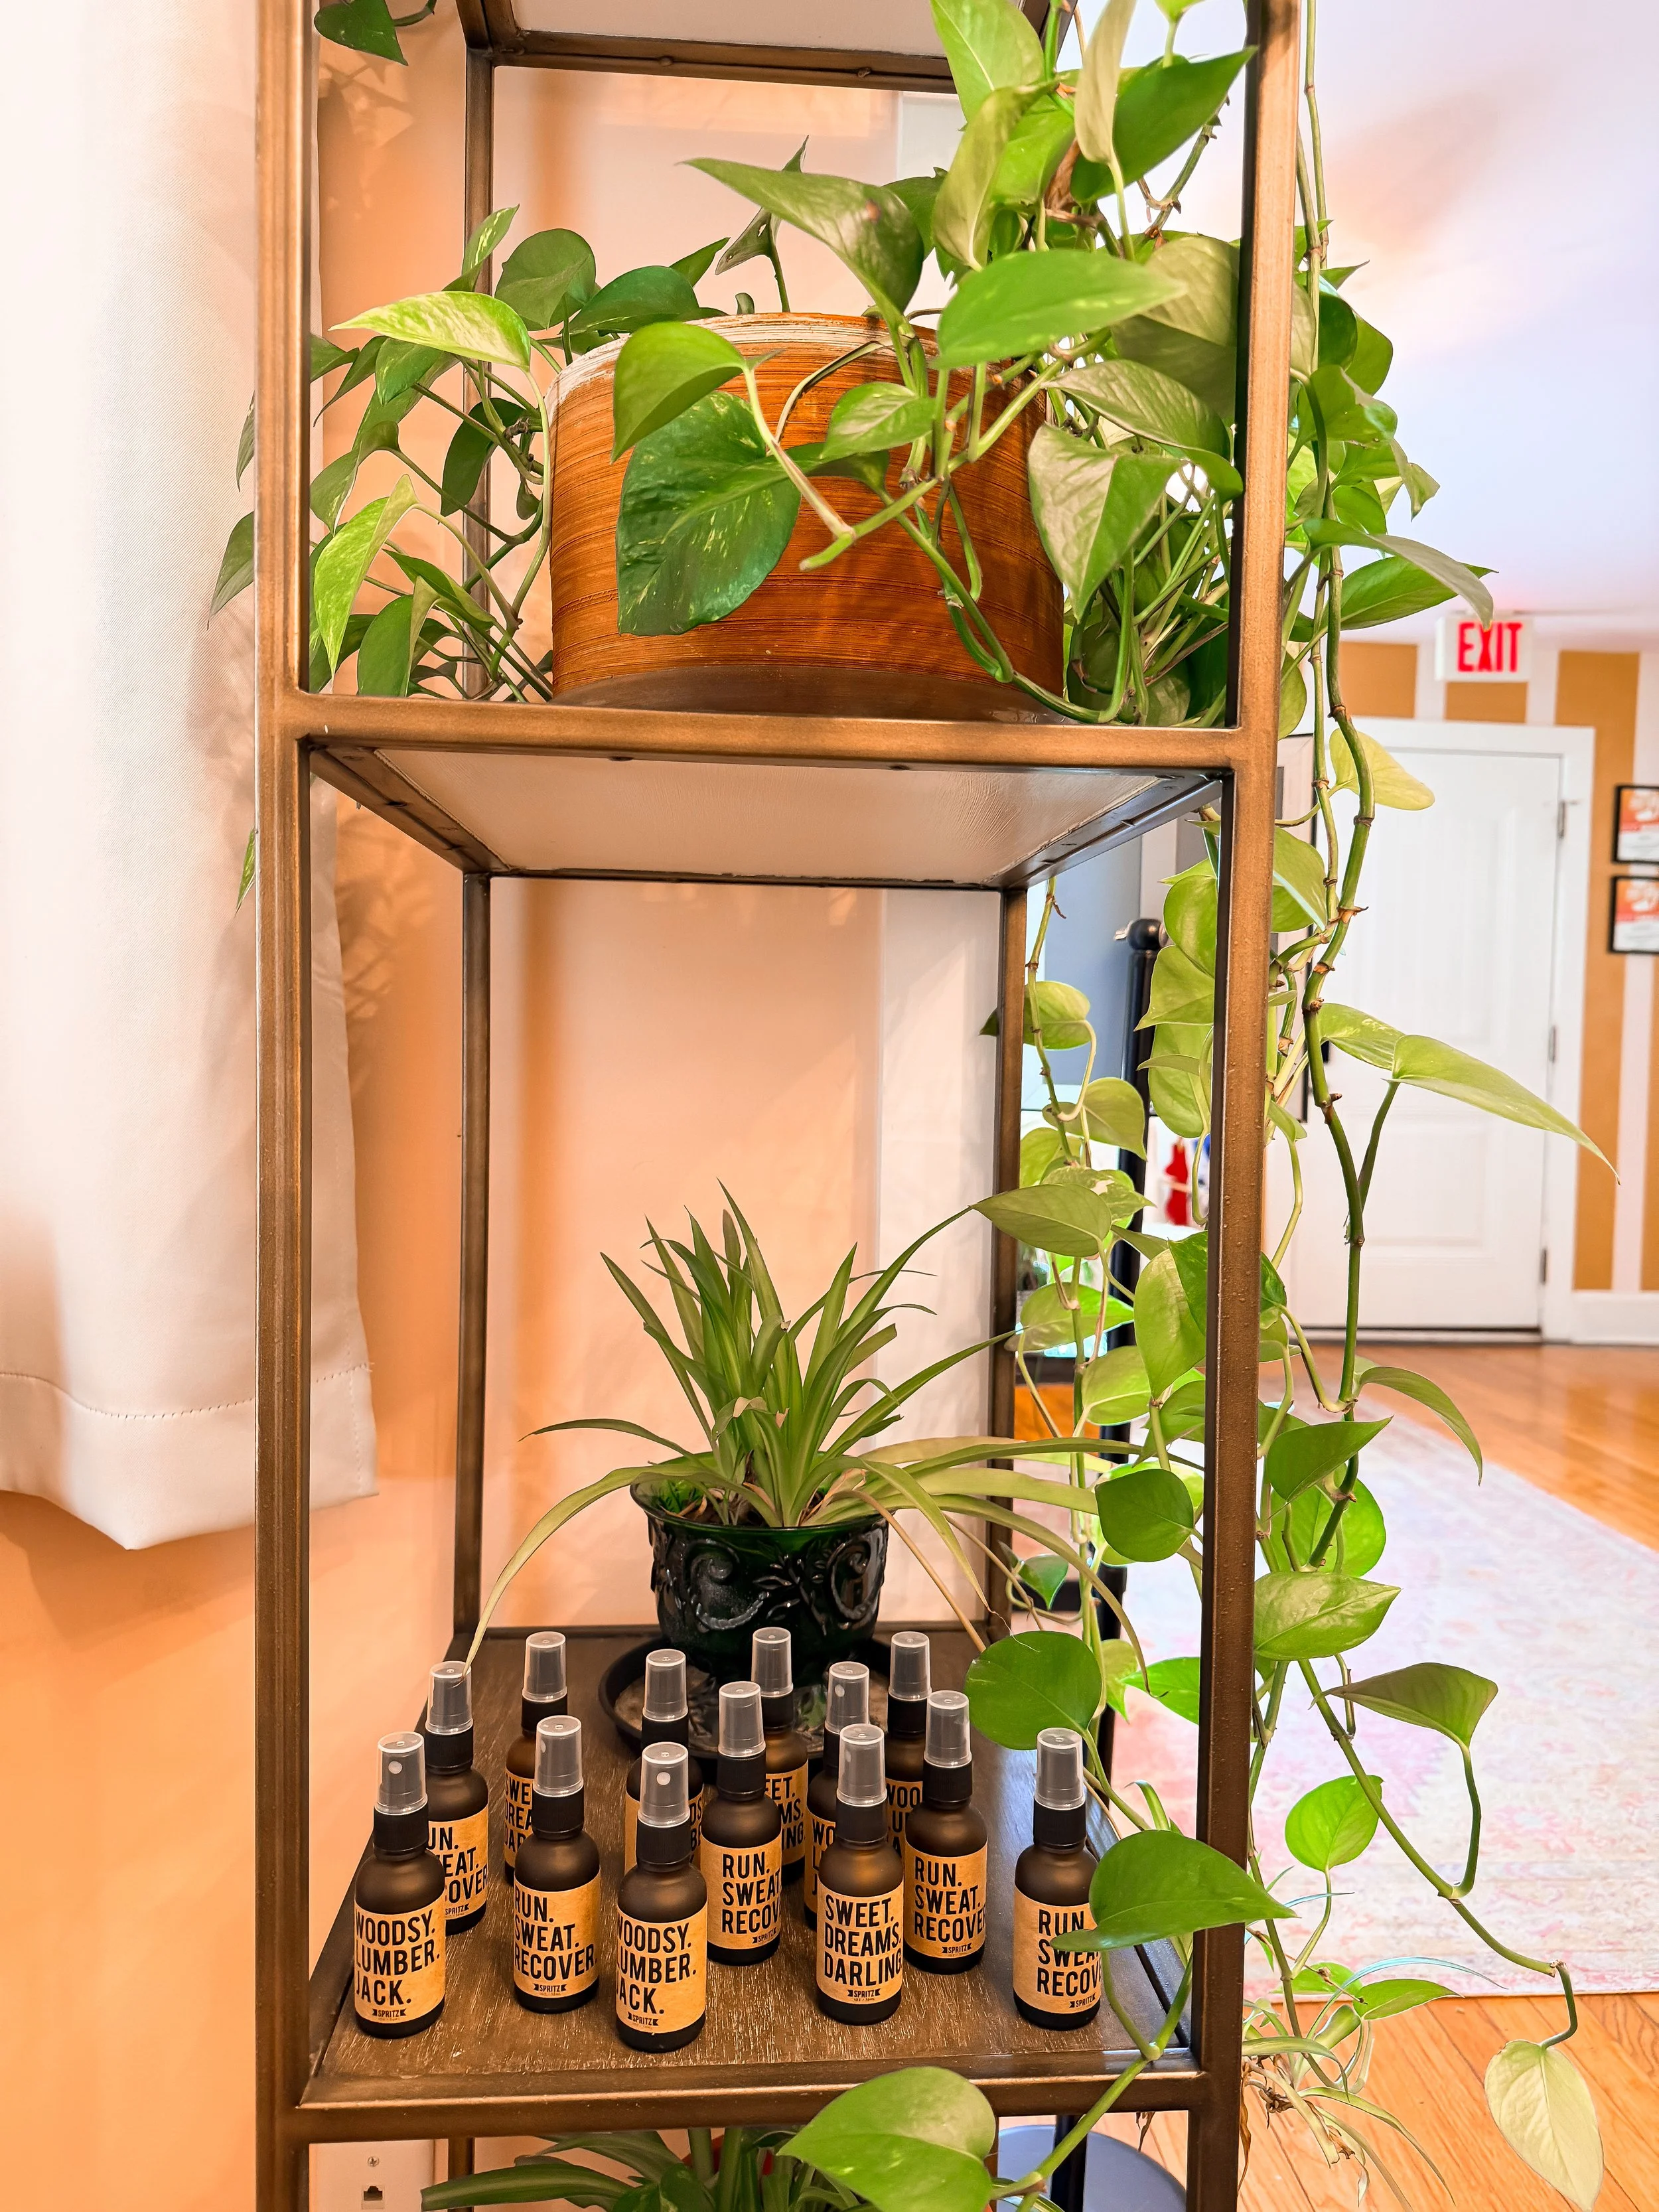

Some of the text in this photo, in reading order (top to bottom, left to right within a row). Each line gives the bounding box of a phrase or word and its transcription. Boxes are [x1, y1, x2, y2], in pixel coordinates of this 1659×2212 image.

[1458, 622, 1522, 672] EXIT
[722, 1852, 770, 1879] RUN.
[914, 1856, 962, 1887] RUN.
[515, 1884, 554, 1923] RUN.
[722, 1868, 780, 1906] SWEAT
[914, 1885, 981, 1915] SWEAT.
[355, 1909, 435, 1946] WOODSY.
[825, 1894, 894, 1928] SWEET.
[515, 1914, 579, 1952] SWEAT.
[758, 1932, 774, 1942] SPRITZ
[825, 1921, 902, 1956] DREAMS.
[948, 1945, 968, 1954] SPRITZ
[356, 1939, 440, 1976] LUMBER.
[616, 1945, 697, 1983] UMBER.
[356, 1970, 411, 2006] JACK.
[1076, 1996, 1092, 2008] SPRITZ
[378, 2009, 399, 2018] SPRITZ
[632, 2015, 652, 2026] SPRITZ
